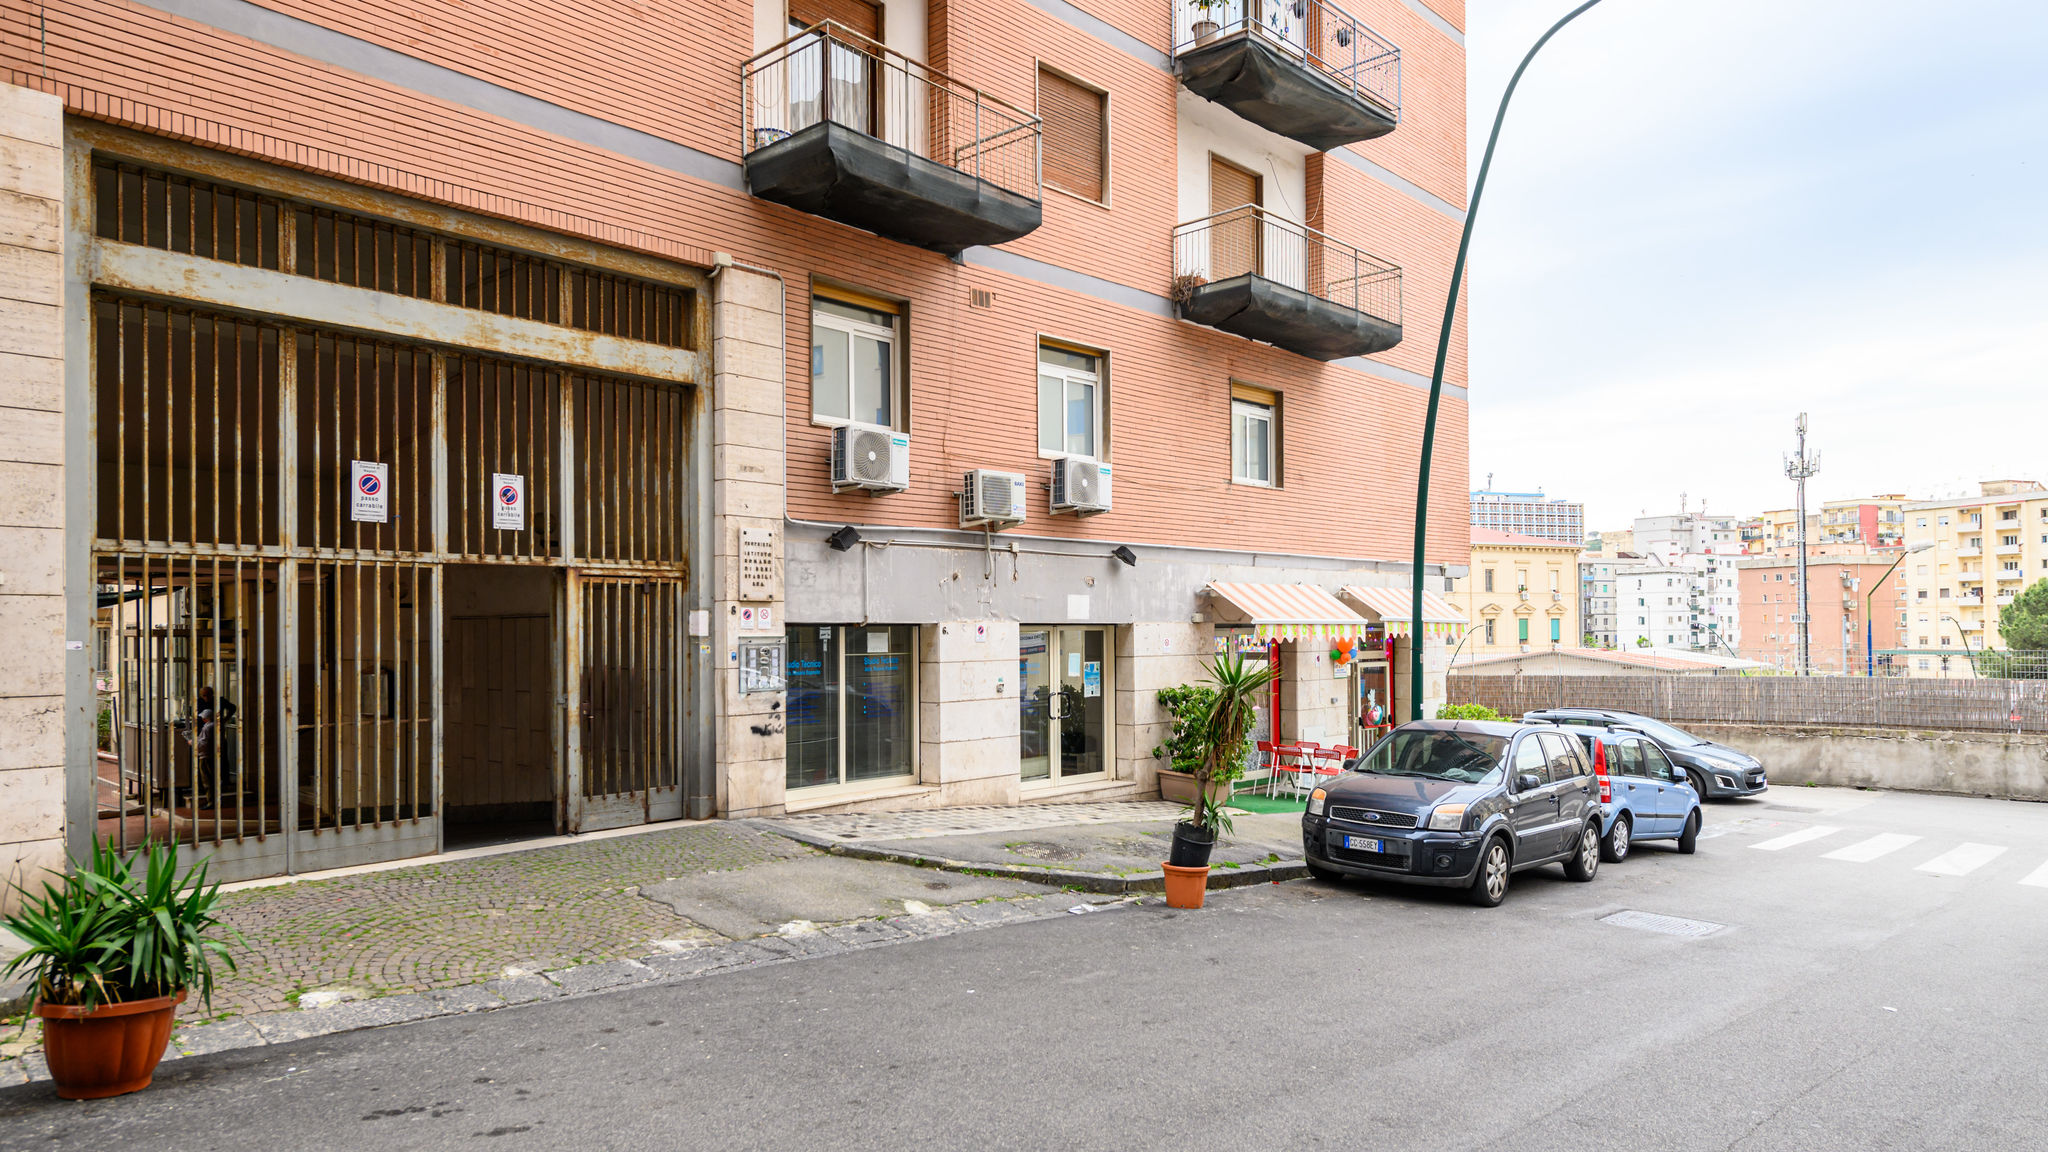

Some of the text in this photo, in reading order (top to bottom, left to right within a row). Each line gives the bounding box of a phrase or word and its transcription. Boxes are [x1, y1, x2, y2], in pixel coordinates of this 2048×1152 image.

[1259, 624, 1363, 636] GIOCOLANDIA
[1387, 621, 1466, 633] GIOLANDIA
[801, 660, 821, 668] Tecnico
